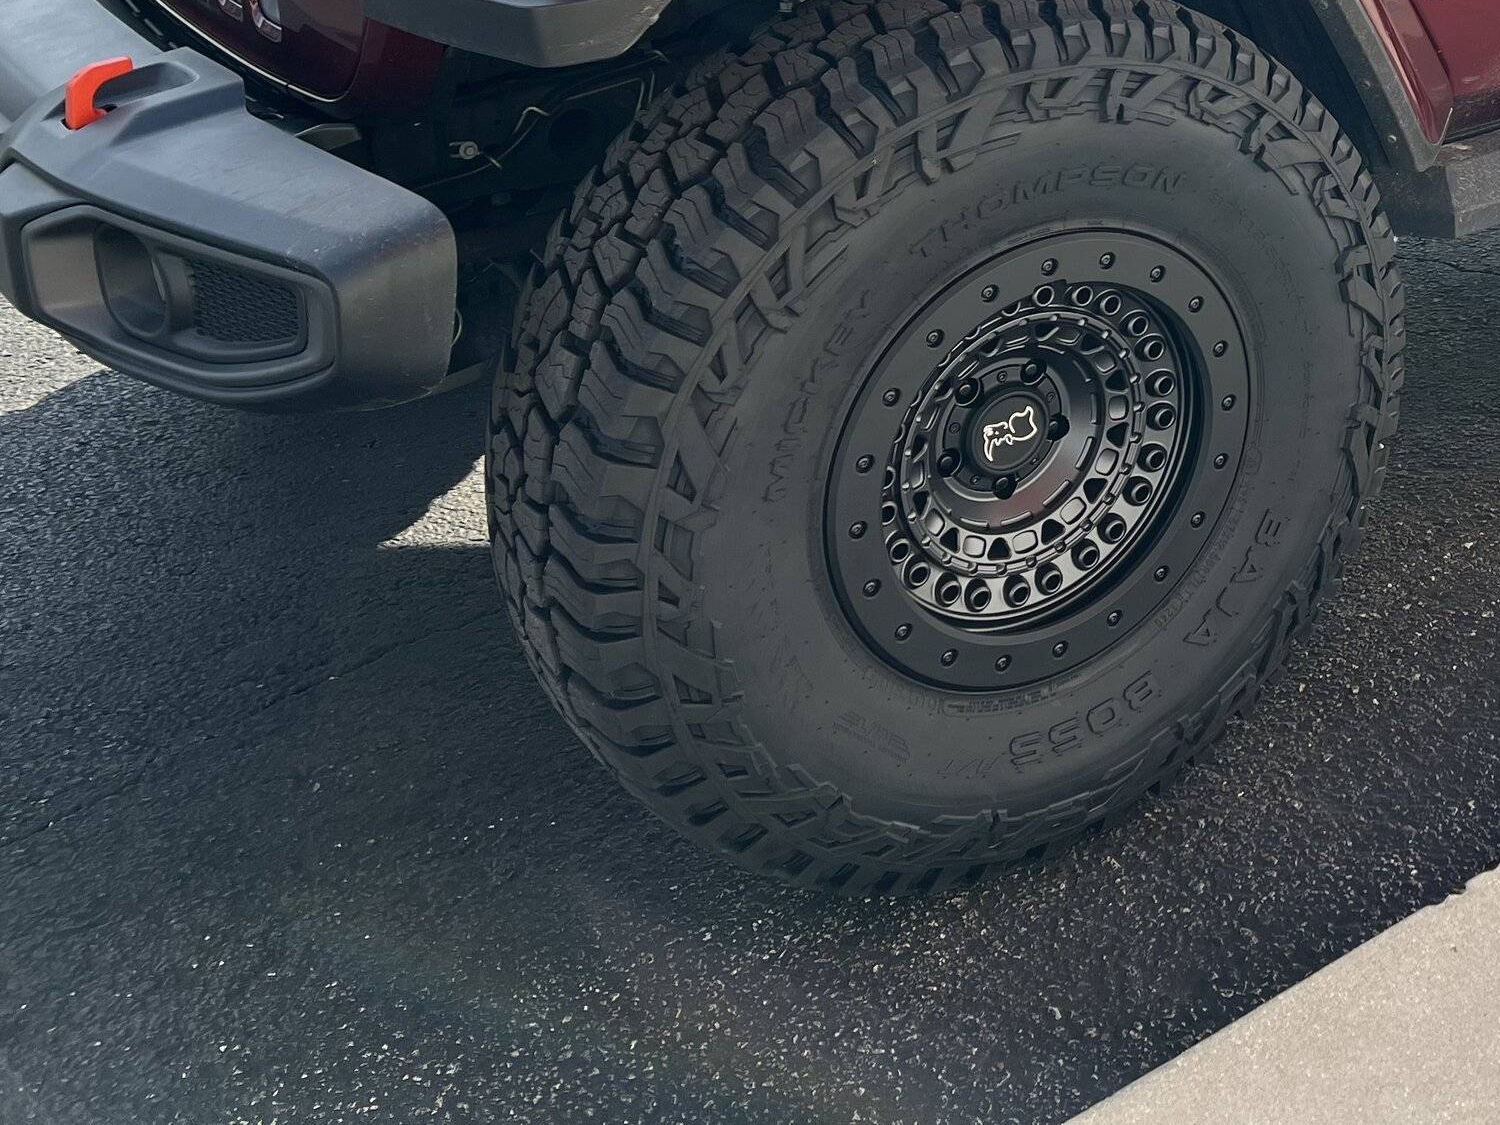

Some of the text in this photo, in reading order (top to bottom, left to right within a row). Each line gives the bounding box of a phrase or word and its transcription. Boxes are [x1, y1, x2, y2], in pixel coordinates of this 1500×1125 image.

[761, 160, 1188, 505] MICKEY THOMPSON
[1182, 507, 1284, 647] BAJA
[1009, 670, 1156, 769] BOSS
